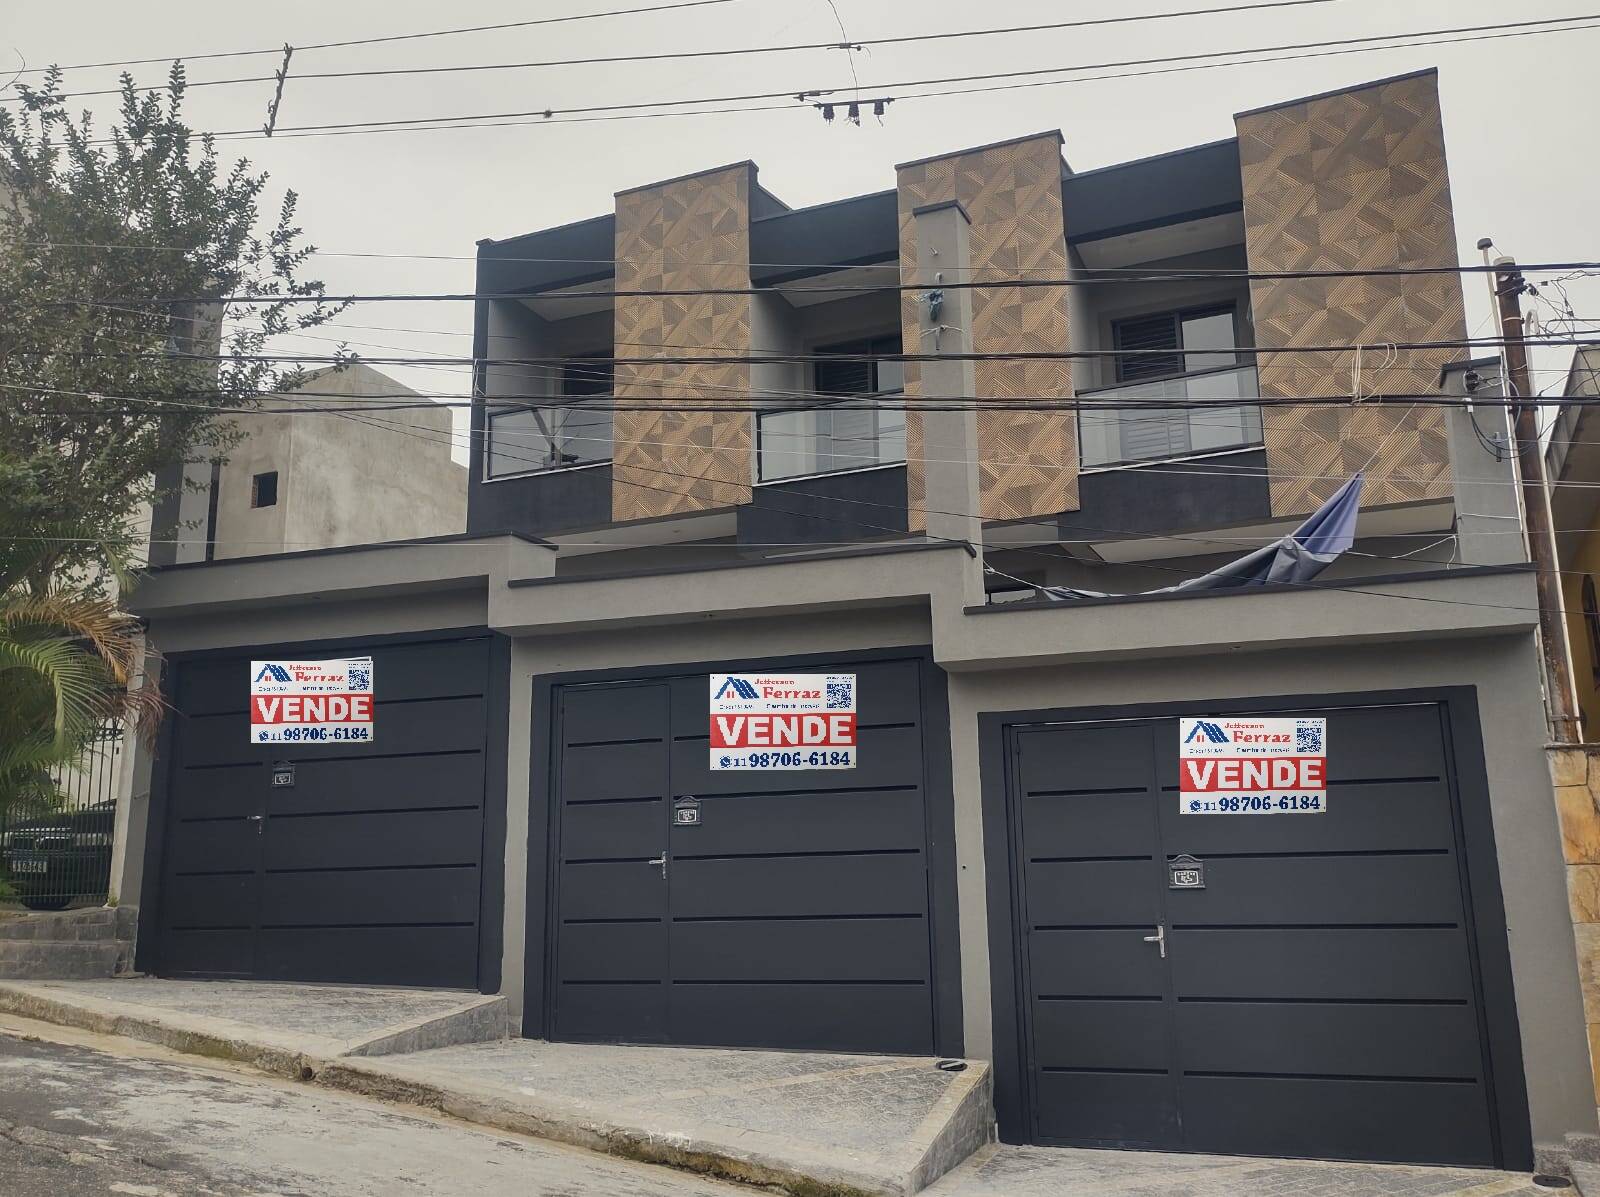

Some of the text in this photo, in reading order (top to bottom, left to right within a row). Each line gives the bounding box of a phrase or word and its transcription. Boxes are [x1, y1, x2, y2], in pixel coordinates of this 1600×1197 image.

[295, 671, 345, 682] Ferraz
[763, 686, 821, 699] Ferraz
[256, 696, 371, 723] VENDE
[284, 727, 369, 741] 98706-6184
[716, 715, 852, 746] VENDE
[1233, 730, 1291, 743] Ferraz
[733, 751, 851, 768] 11 98706-6184
[1186, 759, 1322, 790] VENDE
[1203, 795, 1321, 812] 11 98706-6184
